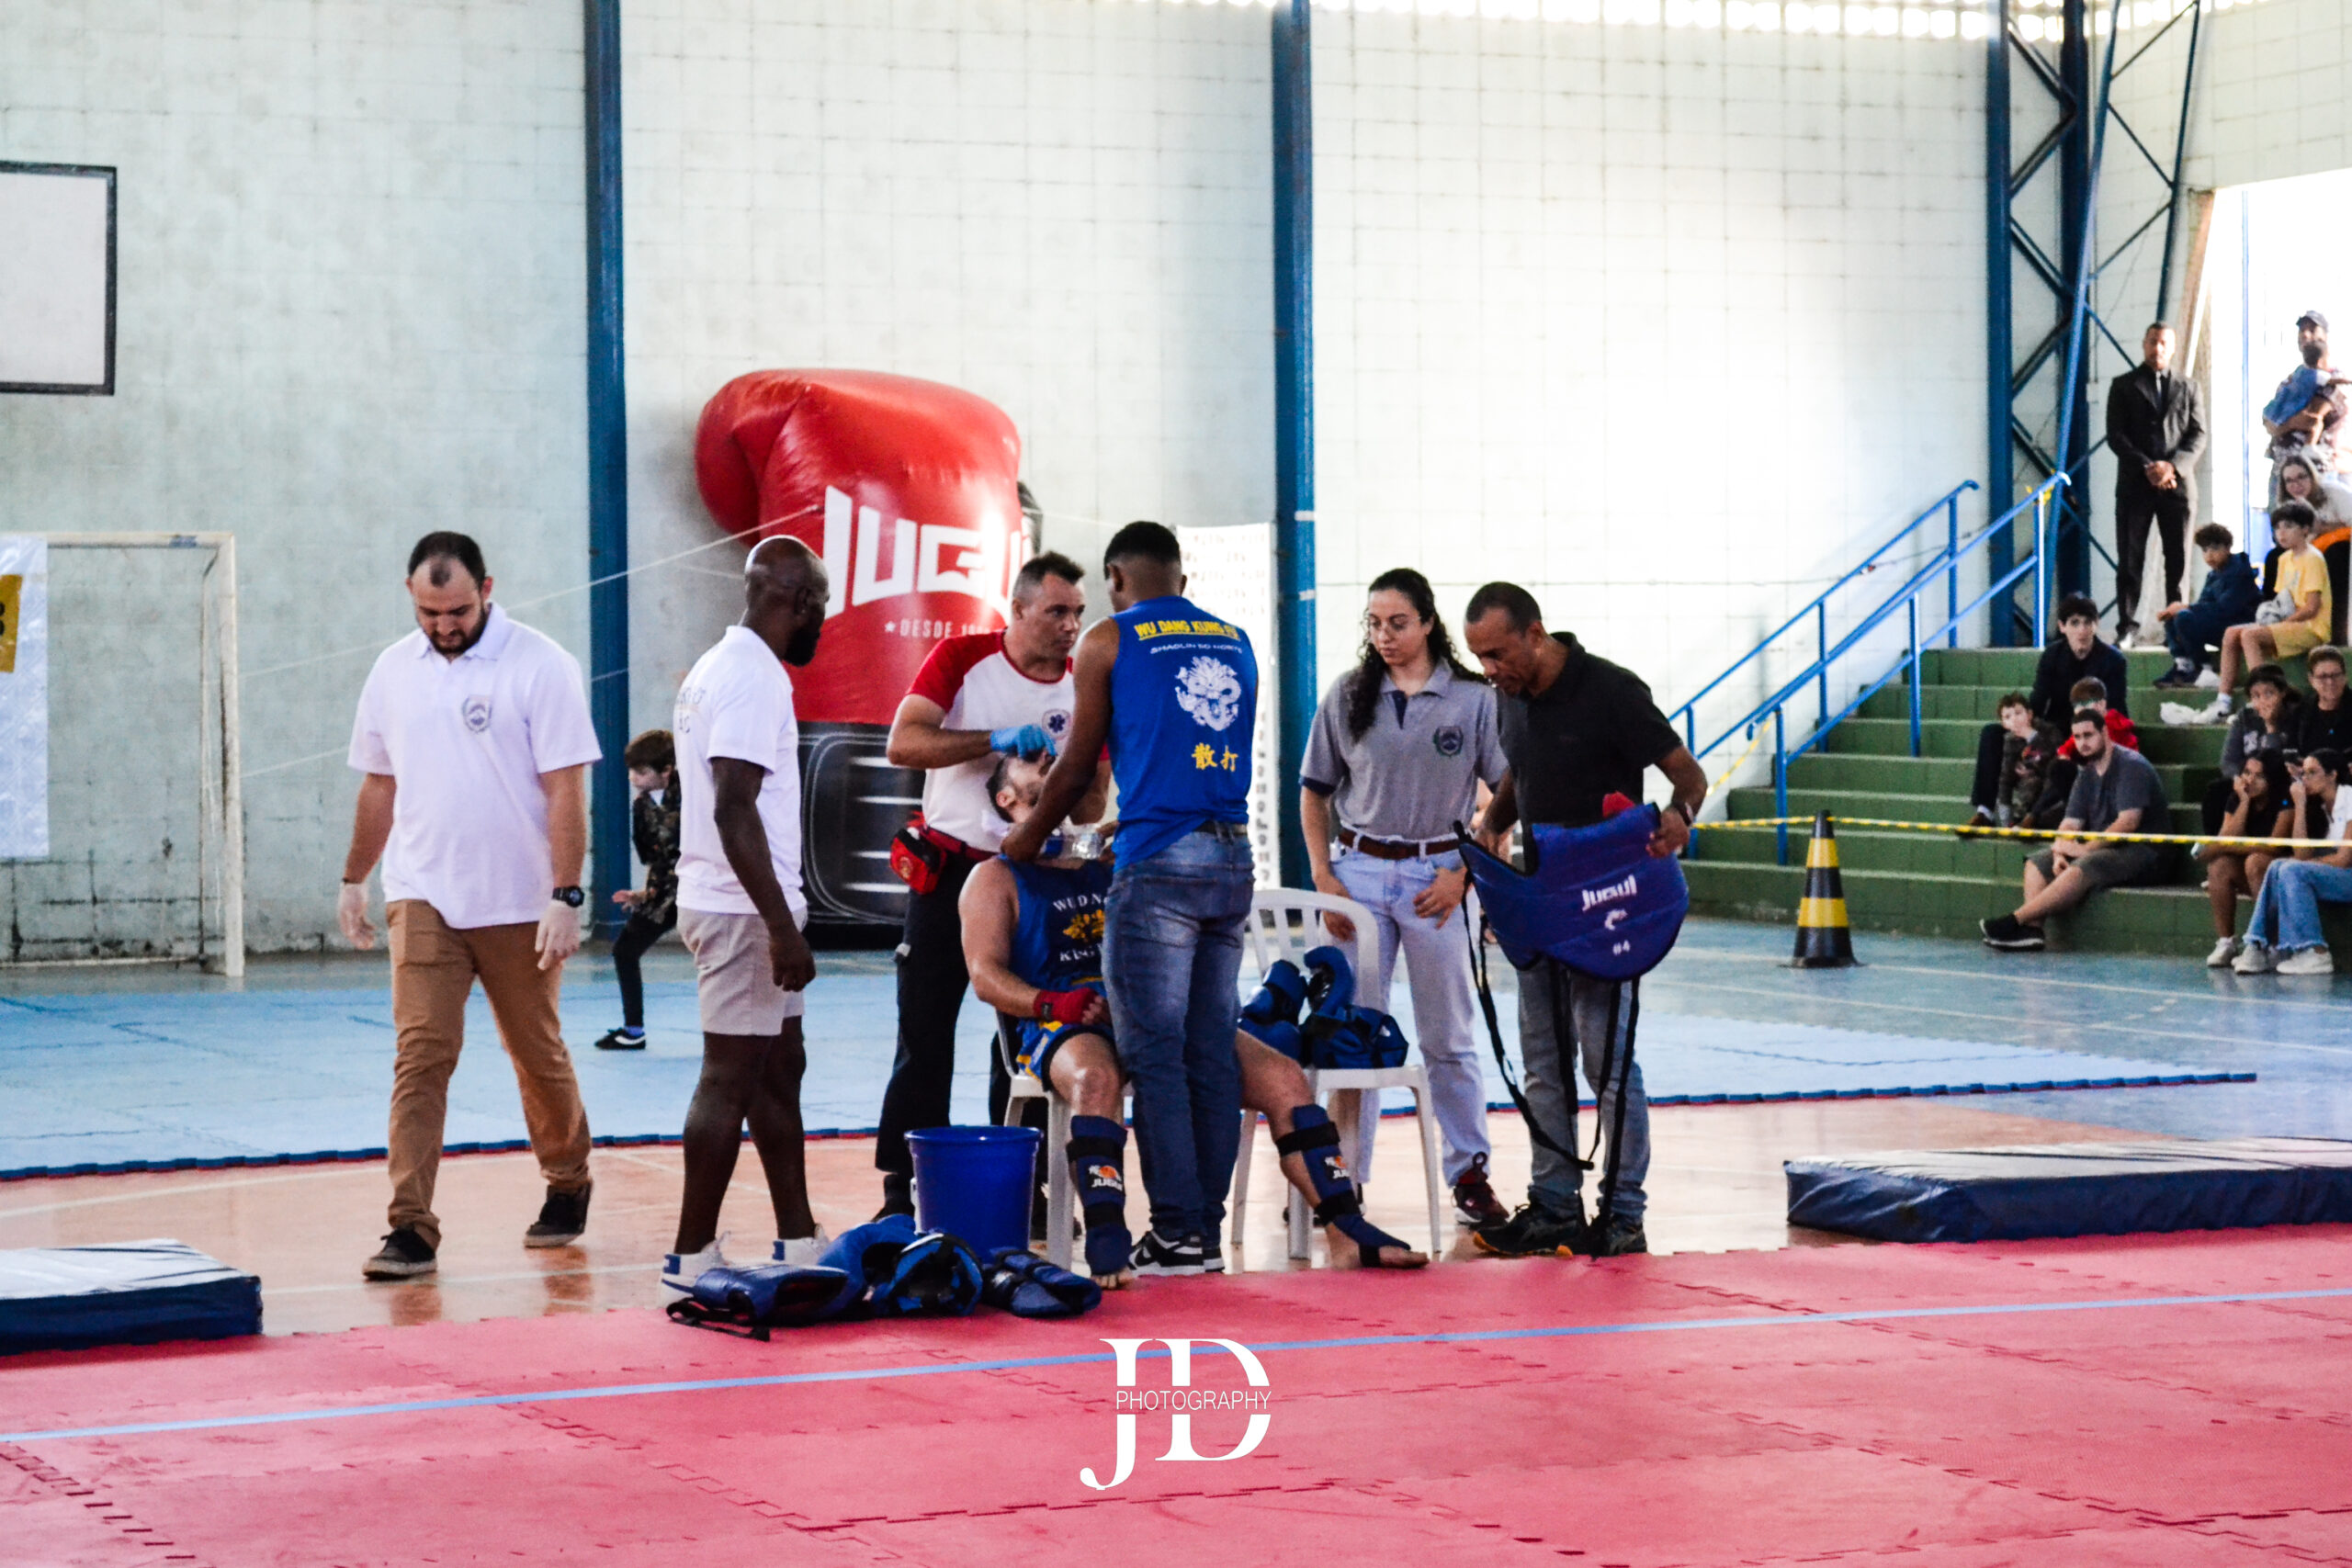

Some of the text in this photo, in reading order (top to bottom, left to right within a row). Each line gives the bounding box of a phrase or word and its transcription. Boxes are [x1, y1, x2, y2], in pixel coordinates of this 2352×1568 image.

[900, 617, 953, 639] DESDE
[1134, 621, 1158, 637] WU
[1158, 619, 1192, 634] DANG
[1191, 620, 1226, 635] KUNG
[1191, 742, 1238, 772] 散打
